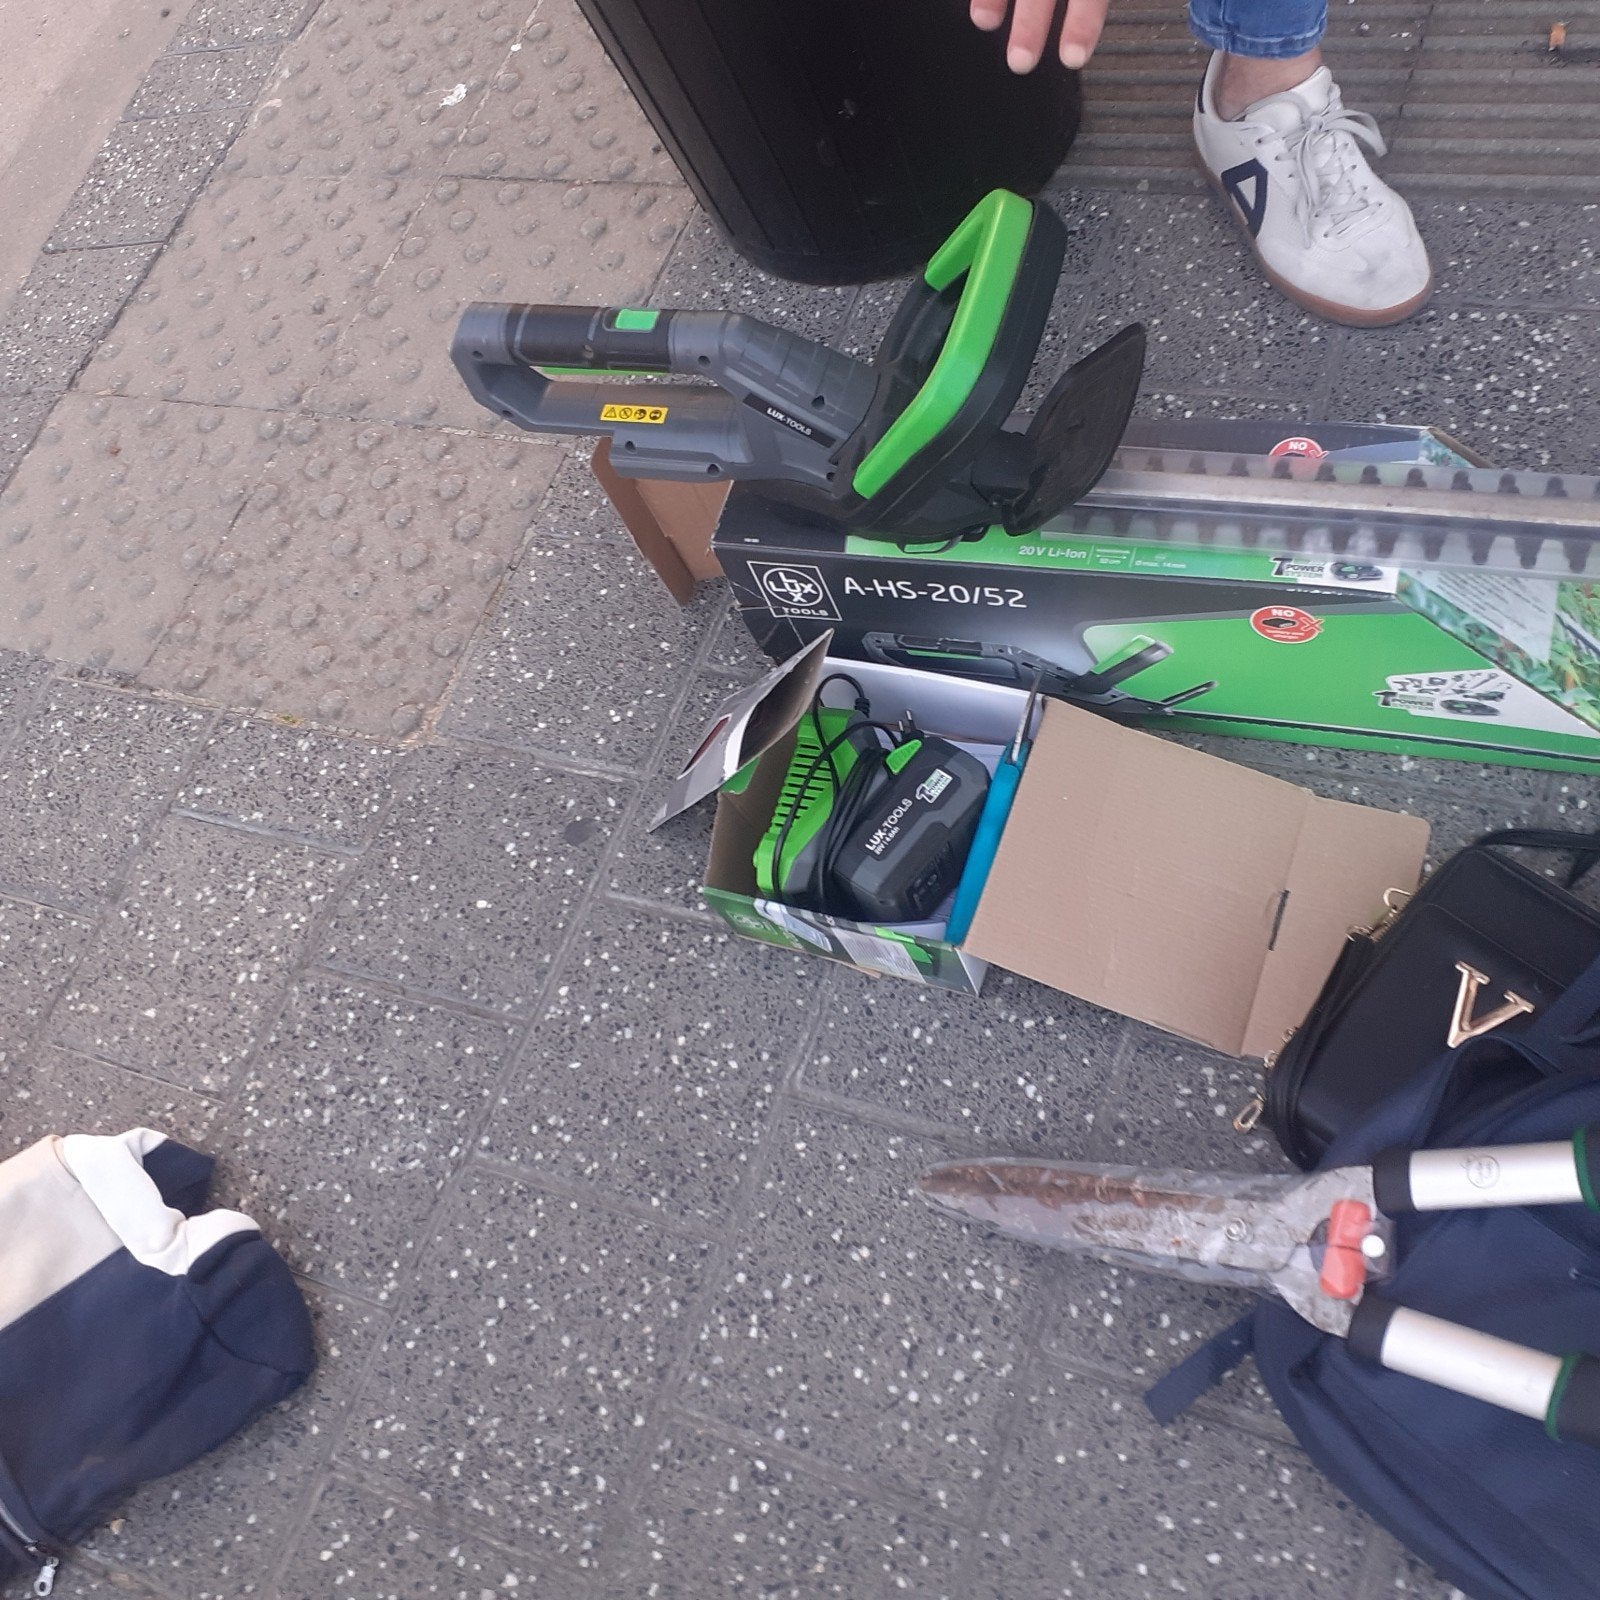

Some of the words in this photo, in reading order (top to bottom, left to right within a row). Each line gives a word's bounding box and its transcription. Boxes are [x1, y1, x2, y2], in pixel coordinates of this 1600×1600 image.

[766, 407, 812, 436] LUX-TOOLS
[1288, 441, 1308, 451] NO
[1048, 548, 1087, 559] Li-Ion
[1286, 563, 1325, 573] POWER
[844, 576, 1027, 609] A-HS-20/52
[782, 606, 829, 617] TOOLS
[1271, 608, 1296, 618] NO
[865, 798, 913, 851] LUX-TOOLS
[1447, 960, 1536, 1049] V
